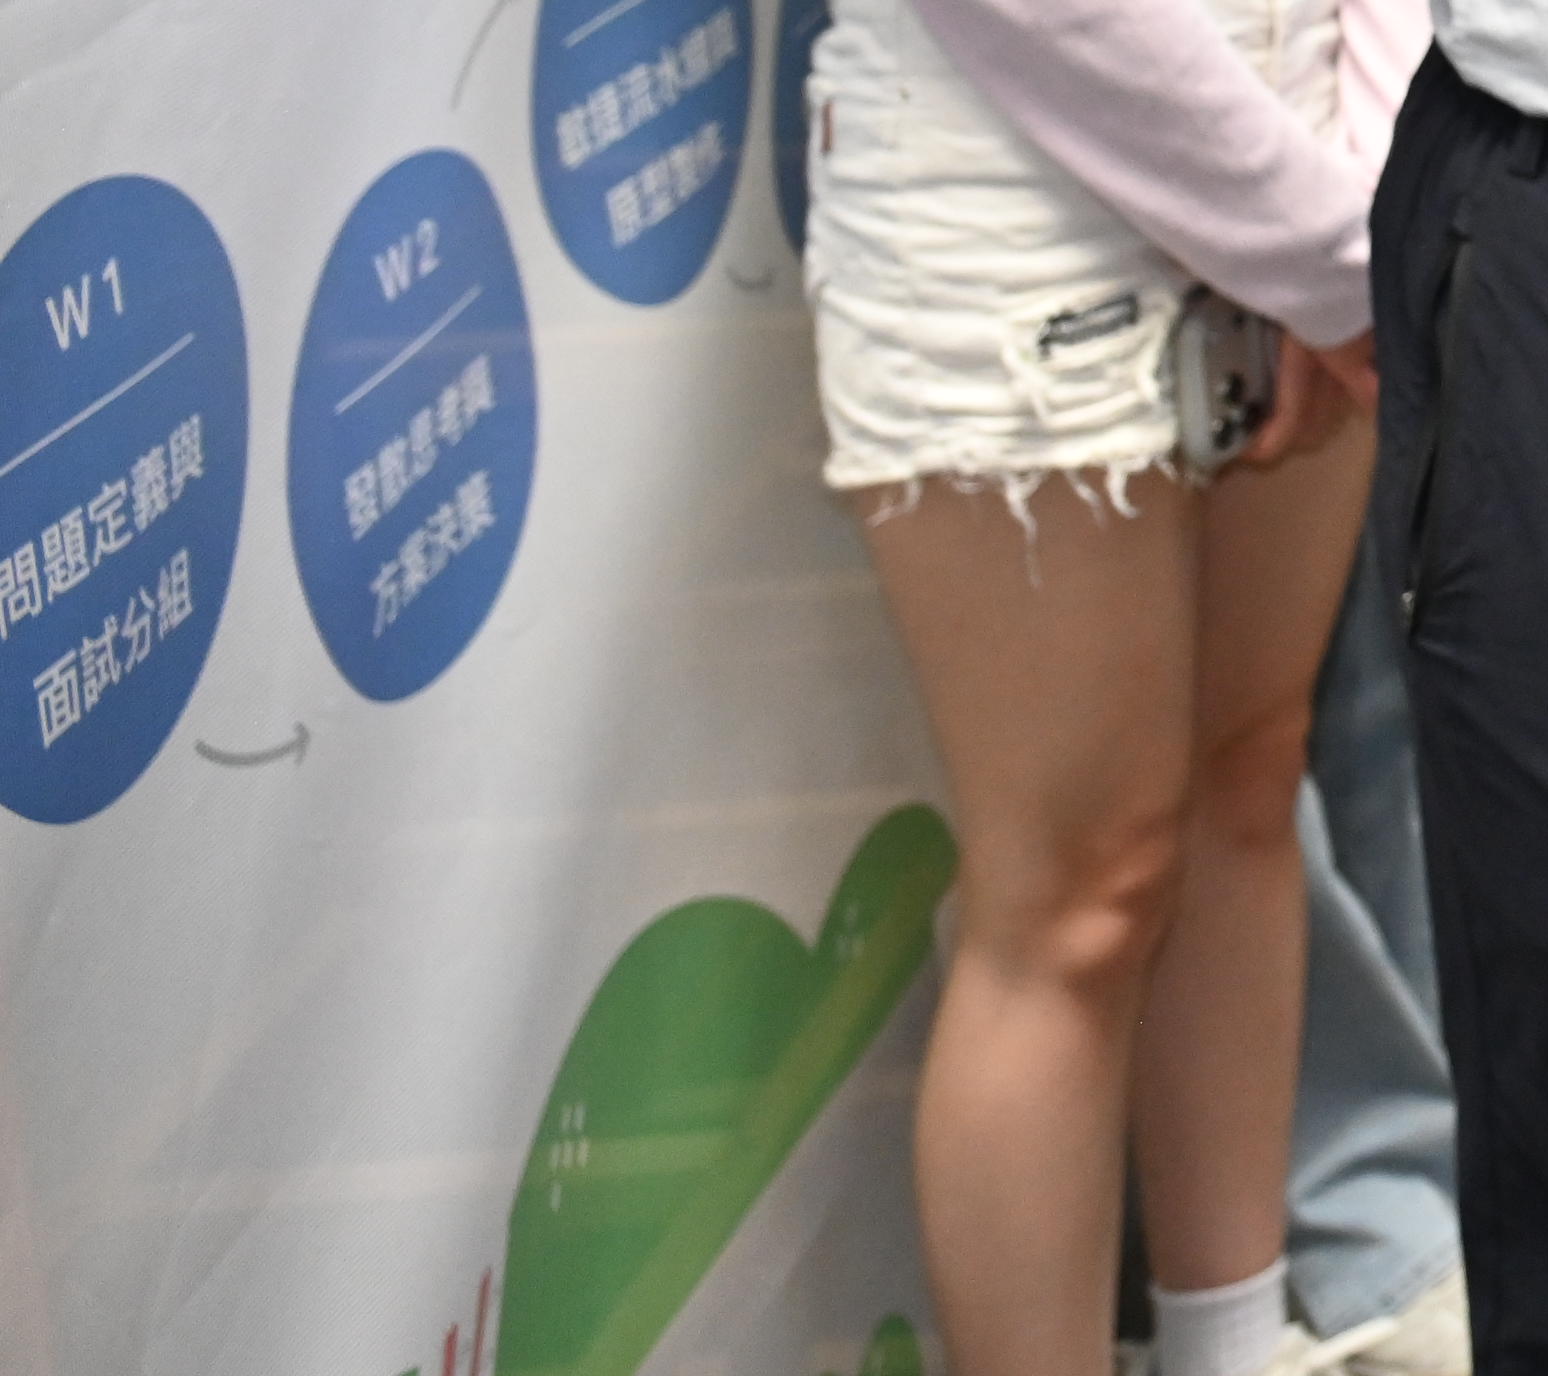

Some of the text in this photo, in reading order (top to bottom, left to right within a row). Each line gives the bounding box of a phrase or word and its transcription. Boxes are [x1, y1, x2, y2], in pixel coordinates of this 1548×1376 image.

[45, 255, 125, 353] W1
[373, 217, 441, 302] W2
[33, 547, 194, 749] 面試分組
